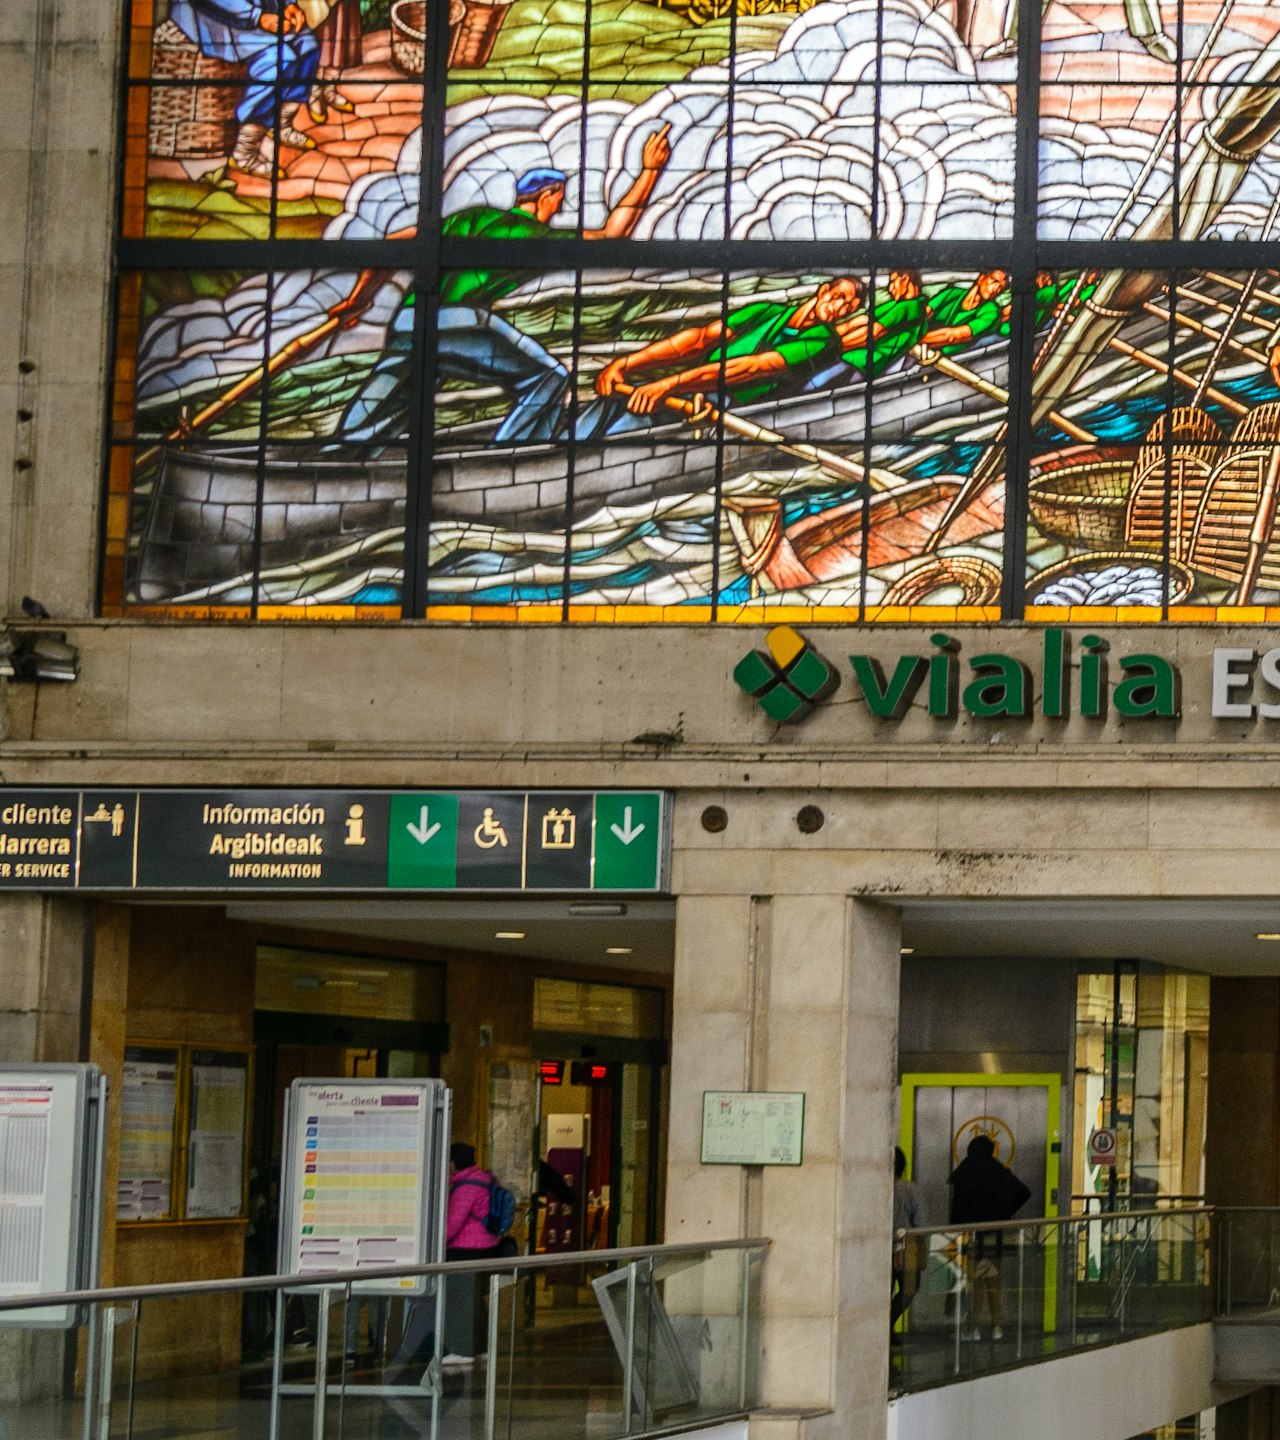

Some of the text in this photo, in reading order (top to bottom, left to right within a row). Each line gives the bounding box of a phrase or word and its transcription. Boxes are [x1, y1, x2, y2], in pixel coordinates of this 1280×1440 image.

[849, 628, 1178, 718] vialia
[2, 803, 72, 824] cliente
[203, 803, 325, 824] Información
[209, 832, 323, 859] Argibideak
[15, 863, 70, 877] SERVICE
[229, 863, 322, 878] INFORMATION
